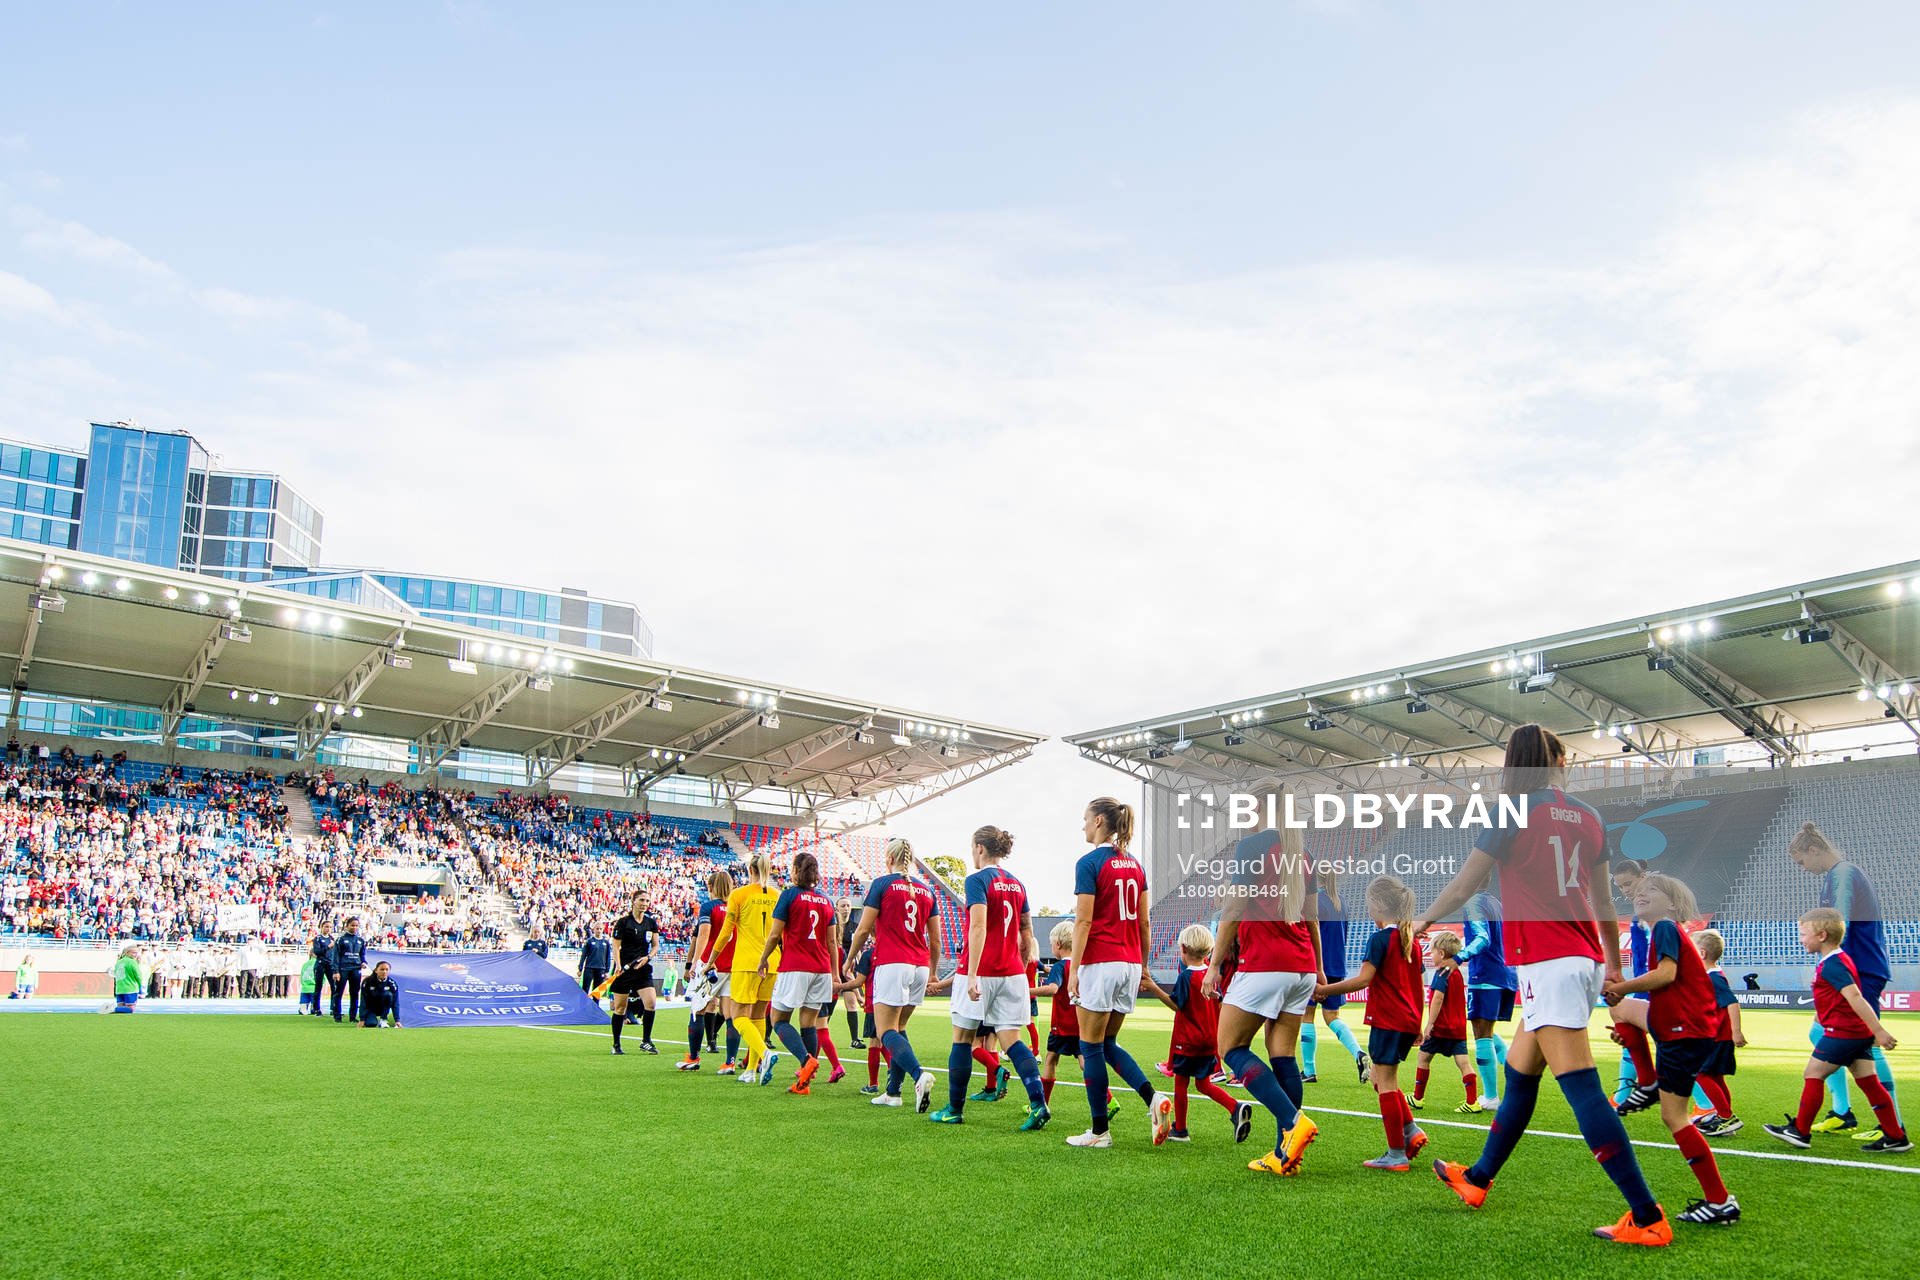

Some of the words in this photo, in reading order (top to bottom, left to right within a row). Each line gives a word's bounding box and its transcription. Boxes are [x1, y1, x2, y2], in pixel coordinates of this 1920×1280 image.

[1549, 807, 1582, 824] ENGEN
[1115, 878, 1139, 921] 10
[762, 912, 766, 938] 1
[808, 910, 820, 939] 2
[904, 900, 918, 932] 3
[430, 983, 495, 993] FRANCE
[496, 984, 529, 993] 2019
[423, 1004, 564, 1016] QUALIFIERS
